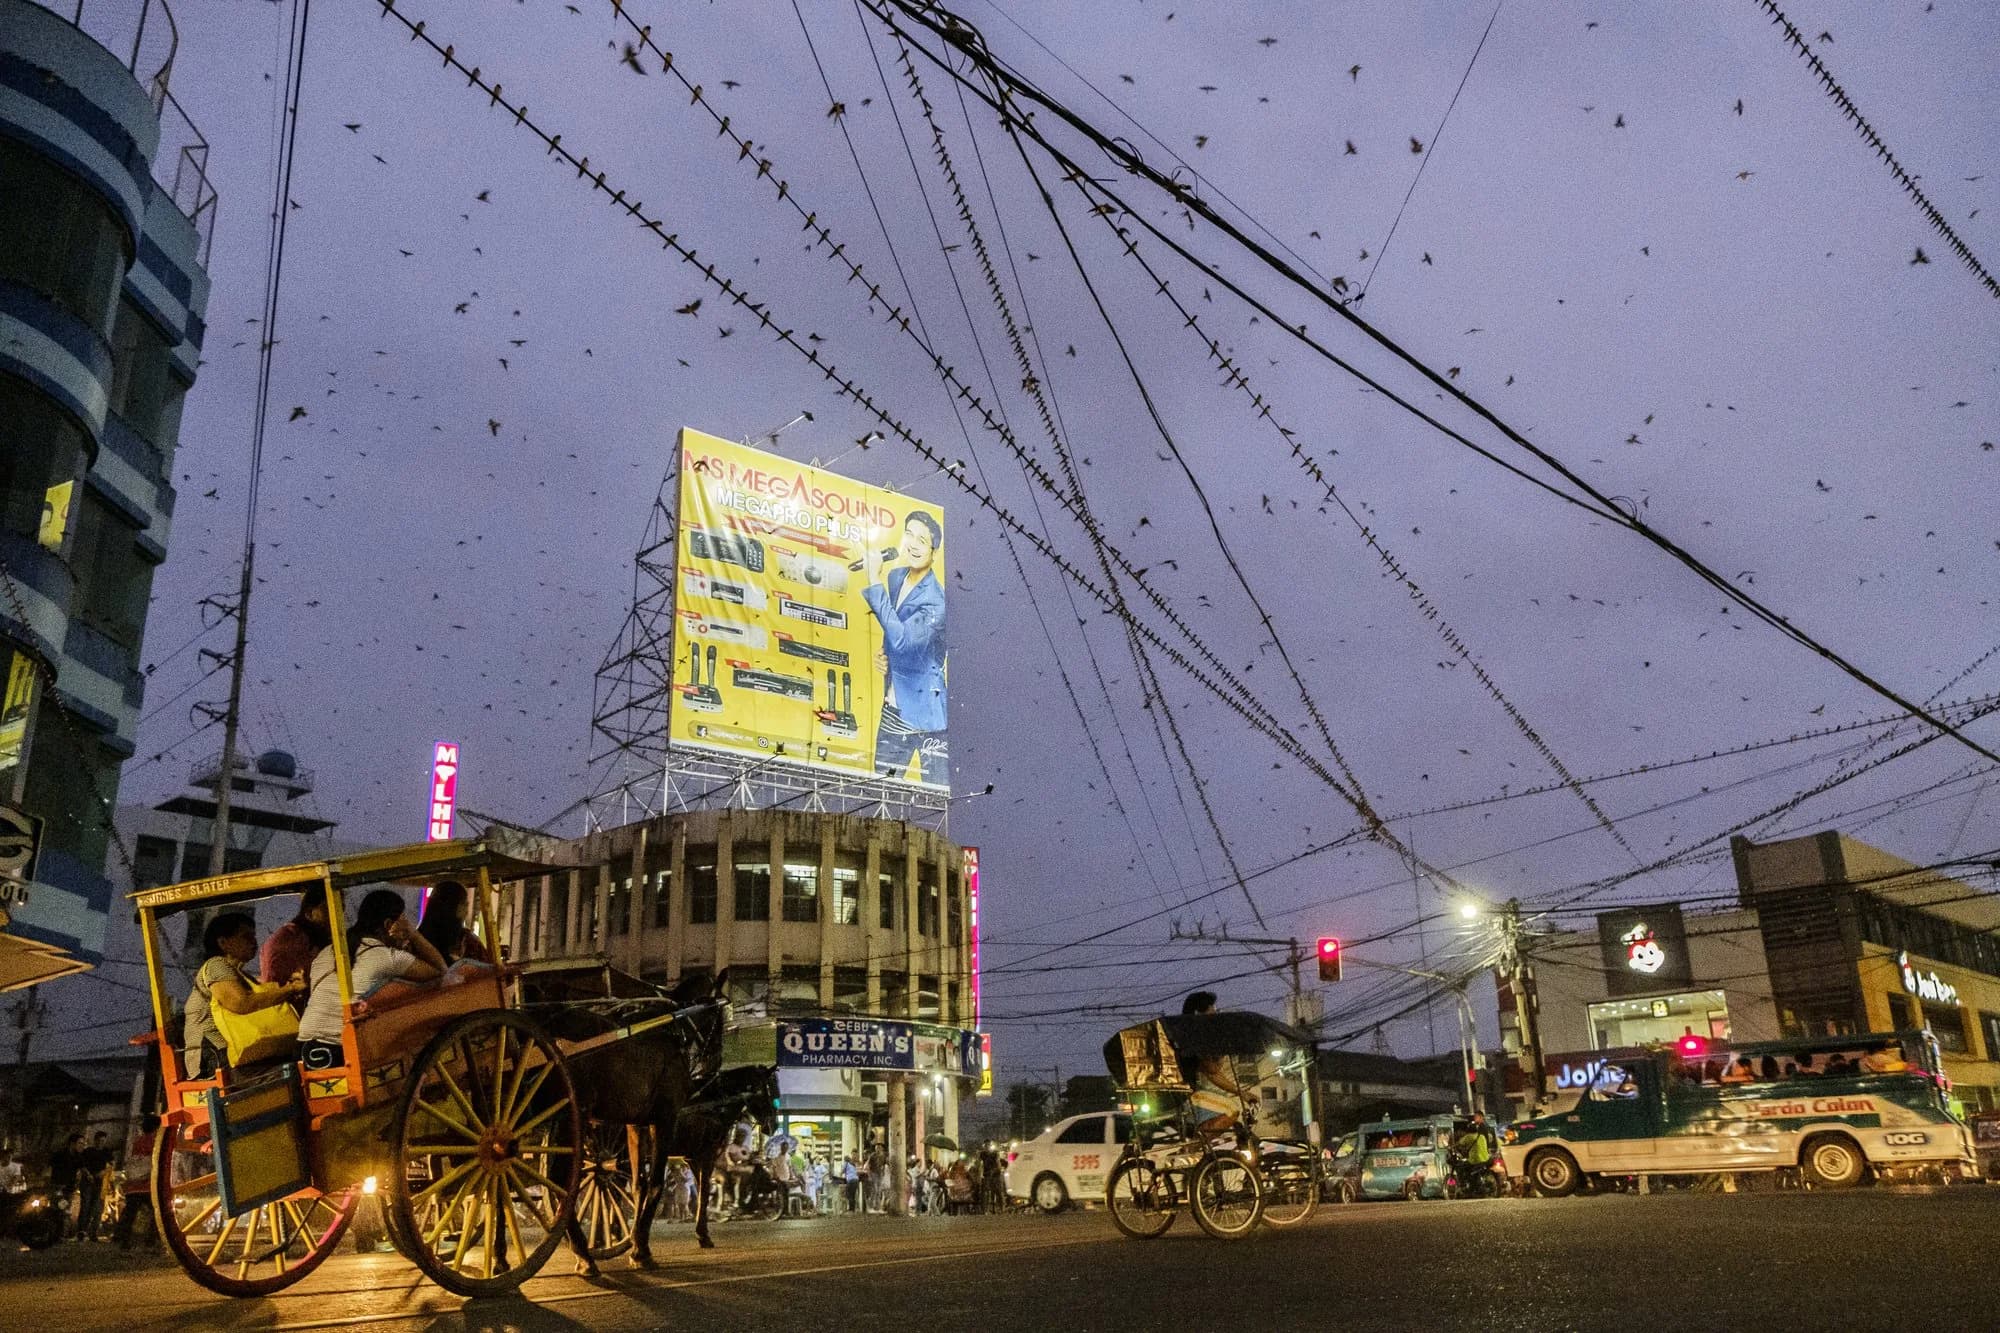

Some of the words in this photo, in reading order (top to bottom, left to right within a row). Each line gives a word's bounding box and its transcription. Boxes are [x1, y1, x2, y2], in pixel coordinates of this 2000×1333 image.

[683, 449, 724, 480] MS
[729, 463, 896, 529] MEGASOUND
[717, 487, 812, 530] MEGAPRO
[815, 514, 862, 544] PLUS
[190, 879, 231, 896] SLATER
[833, 1021, 869, 1032] CEBU
[783, 1032, 909, 1054] QUEEN'S
[1813, 1098, 1875, 1113] Colon
